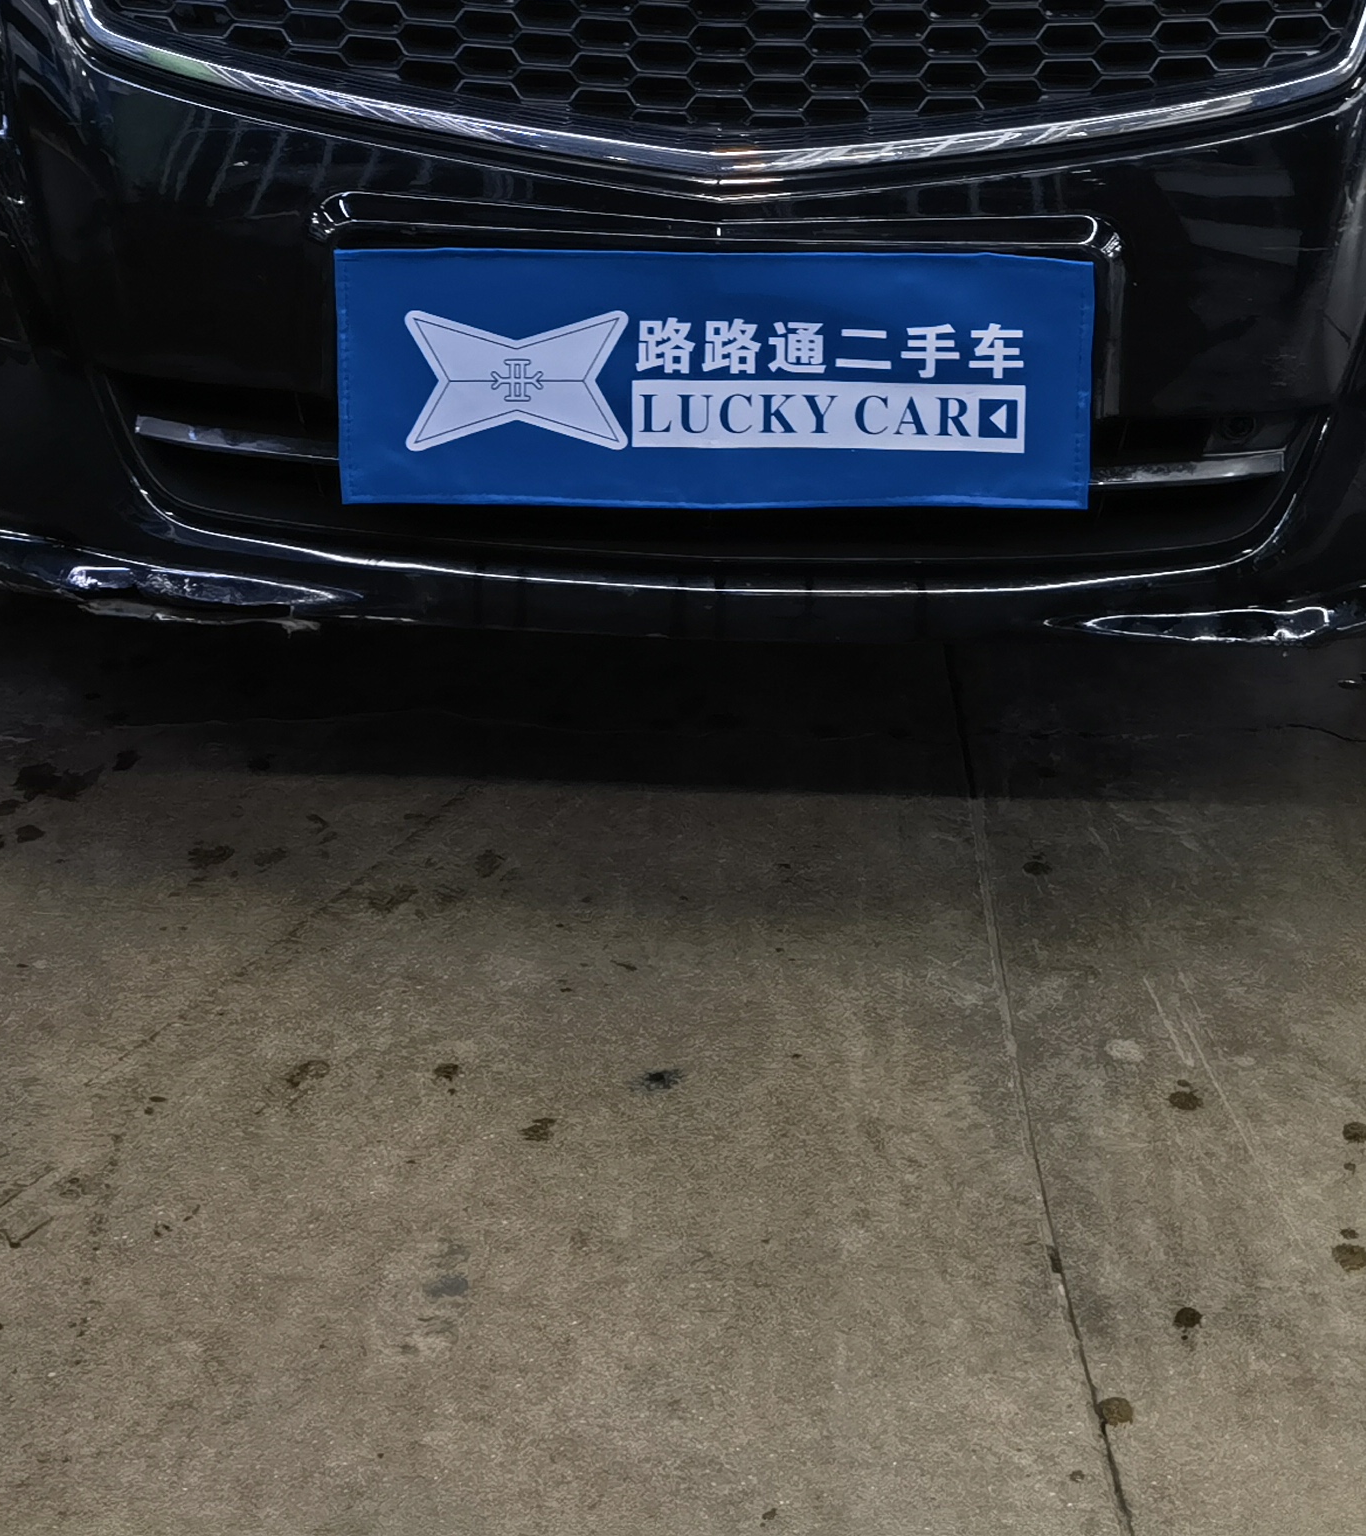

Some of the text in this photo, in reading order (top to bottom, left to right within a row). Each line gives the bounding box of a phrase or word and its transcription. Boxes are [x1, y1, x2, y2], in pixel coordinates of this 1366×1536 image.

[636, 317, 1025, 378] 路路通二手车
[638, 393, 972, 438] LUCKY CAR
